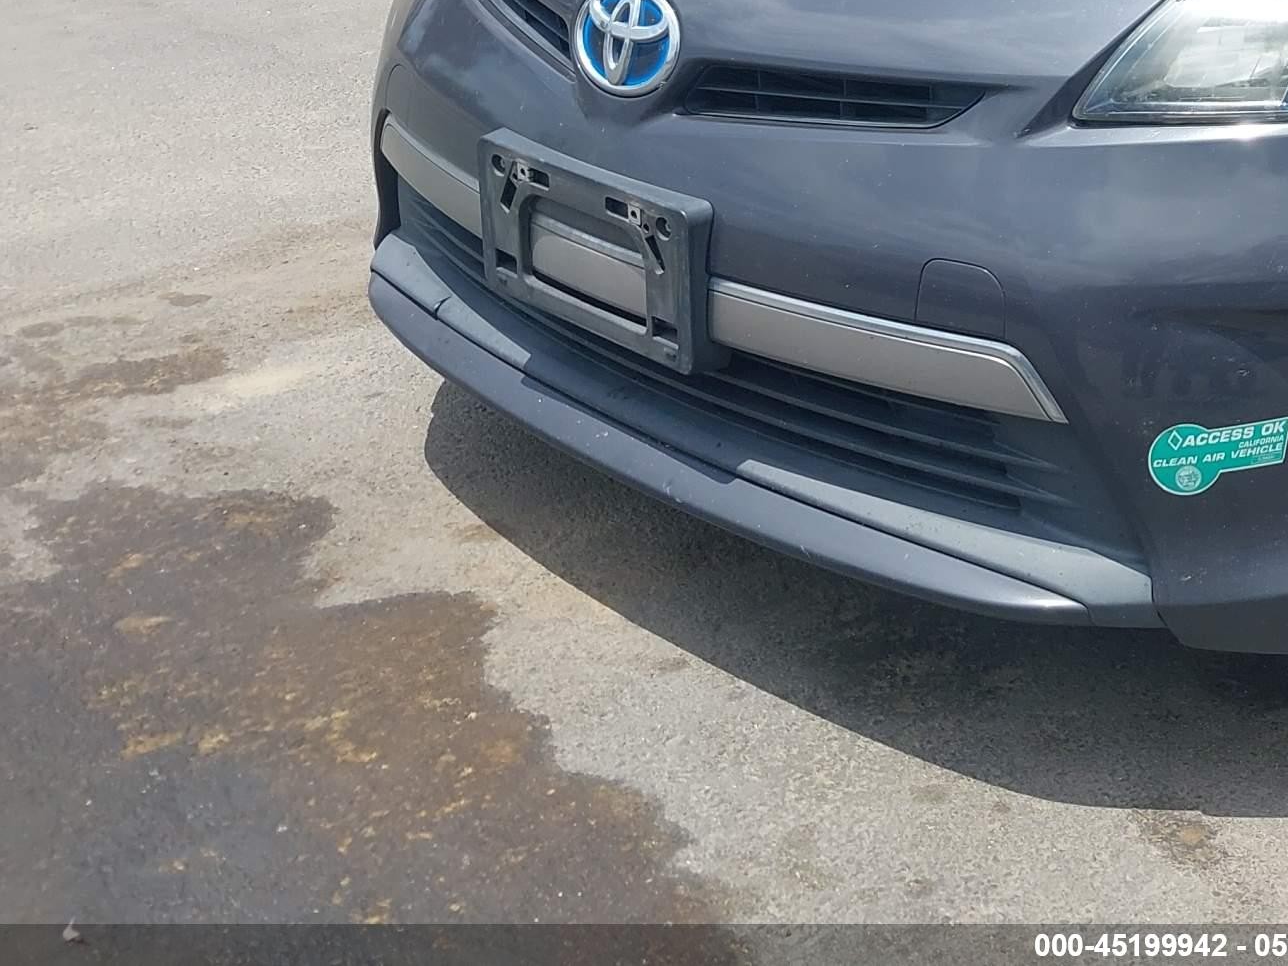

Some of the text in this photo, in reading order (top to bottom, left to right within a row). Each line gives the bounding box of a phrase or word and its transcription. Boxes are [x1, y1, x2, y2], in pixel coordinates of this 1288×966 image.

[1182, 420, 1287, 448] ACCESS OK
[1238, 435, 1284, 449] CALIFORNIA
[1152, 455, 1198, 468] CLEAN
[1202, 451, 1226, 463] AIR
[1230, 442, 1284, 459] VEHICLE
